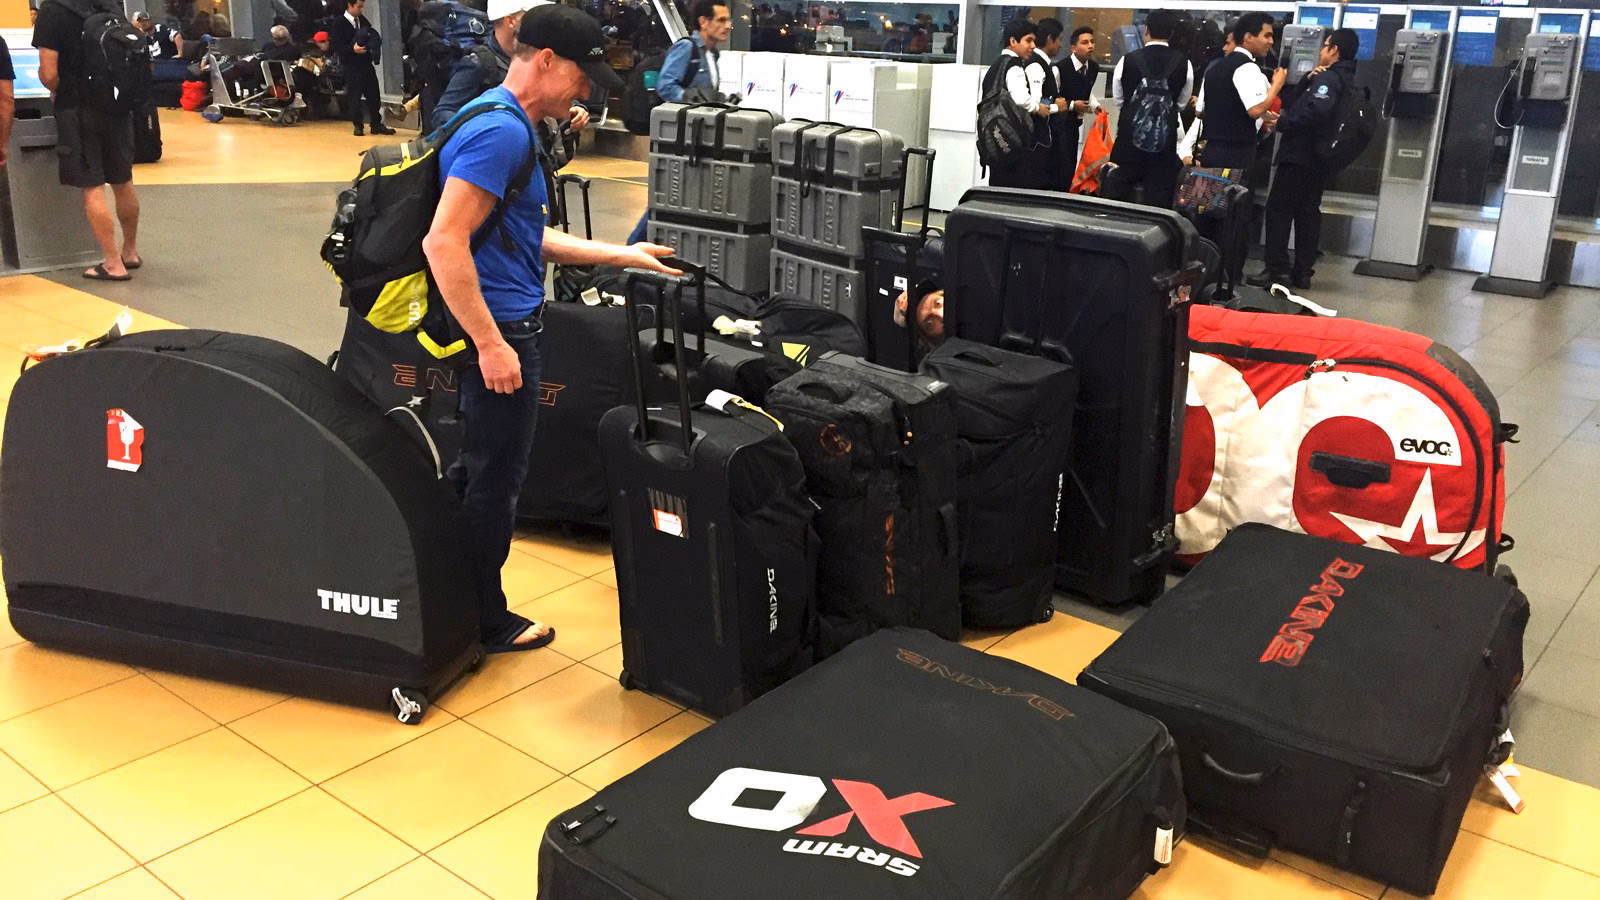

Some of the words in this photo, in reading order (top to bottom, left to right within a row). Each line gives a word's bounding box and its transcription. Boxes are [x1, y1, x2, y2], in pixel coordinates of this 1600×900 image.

[1400, 438, 1451, 456] evoc
[317, 589, 398, 620] THULE
[767, 567, 777, 634] DAKINE
[1260, 558, 1364, 667] DAKINE
[783, 838, 921, 877] SRAM
